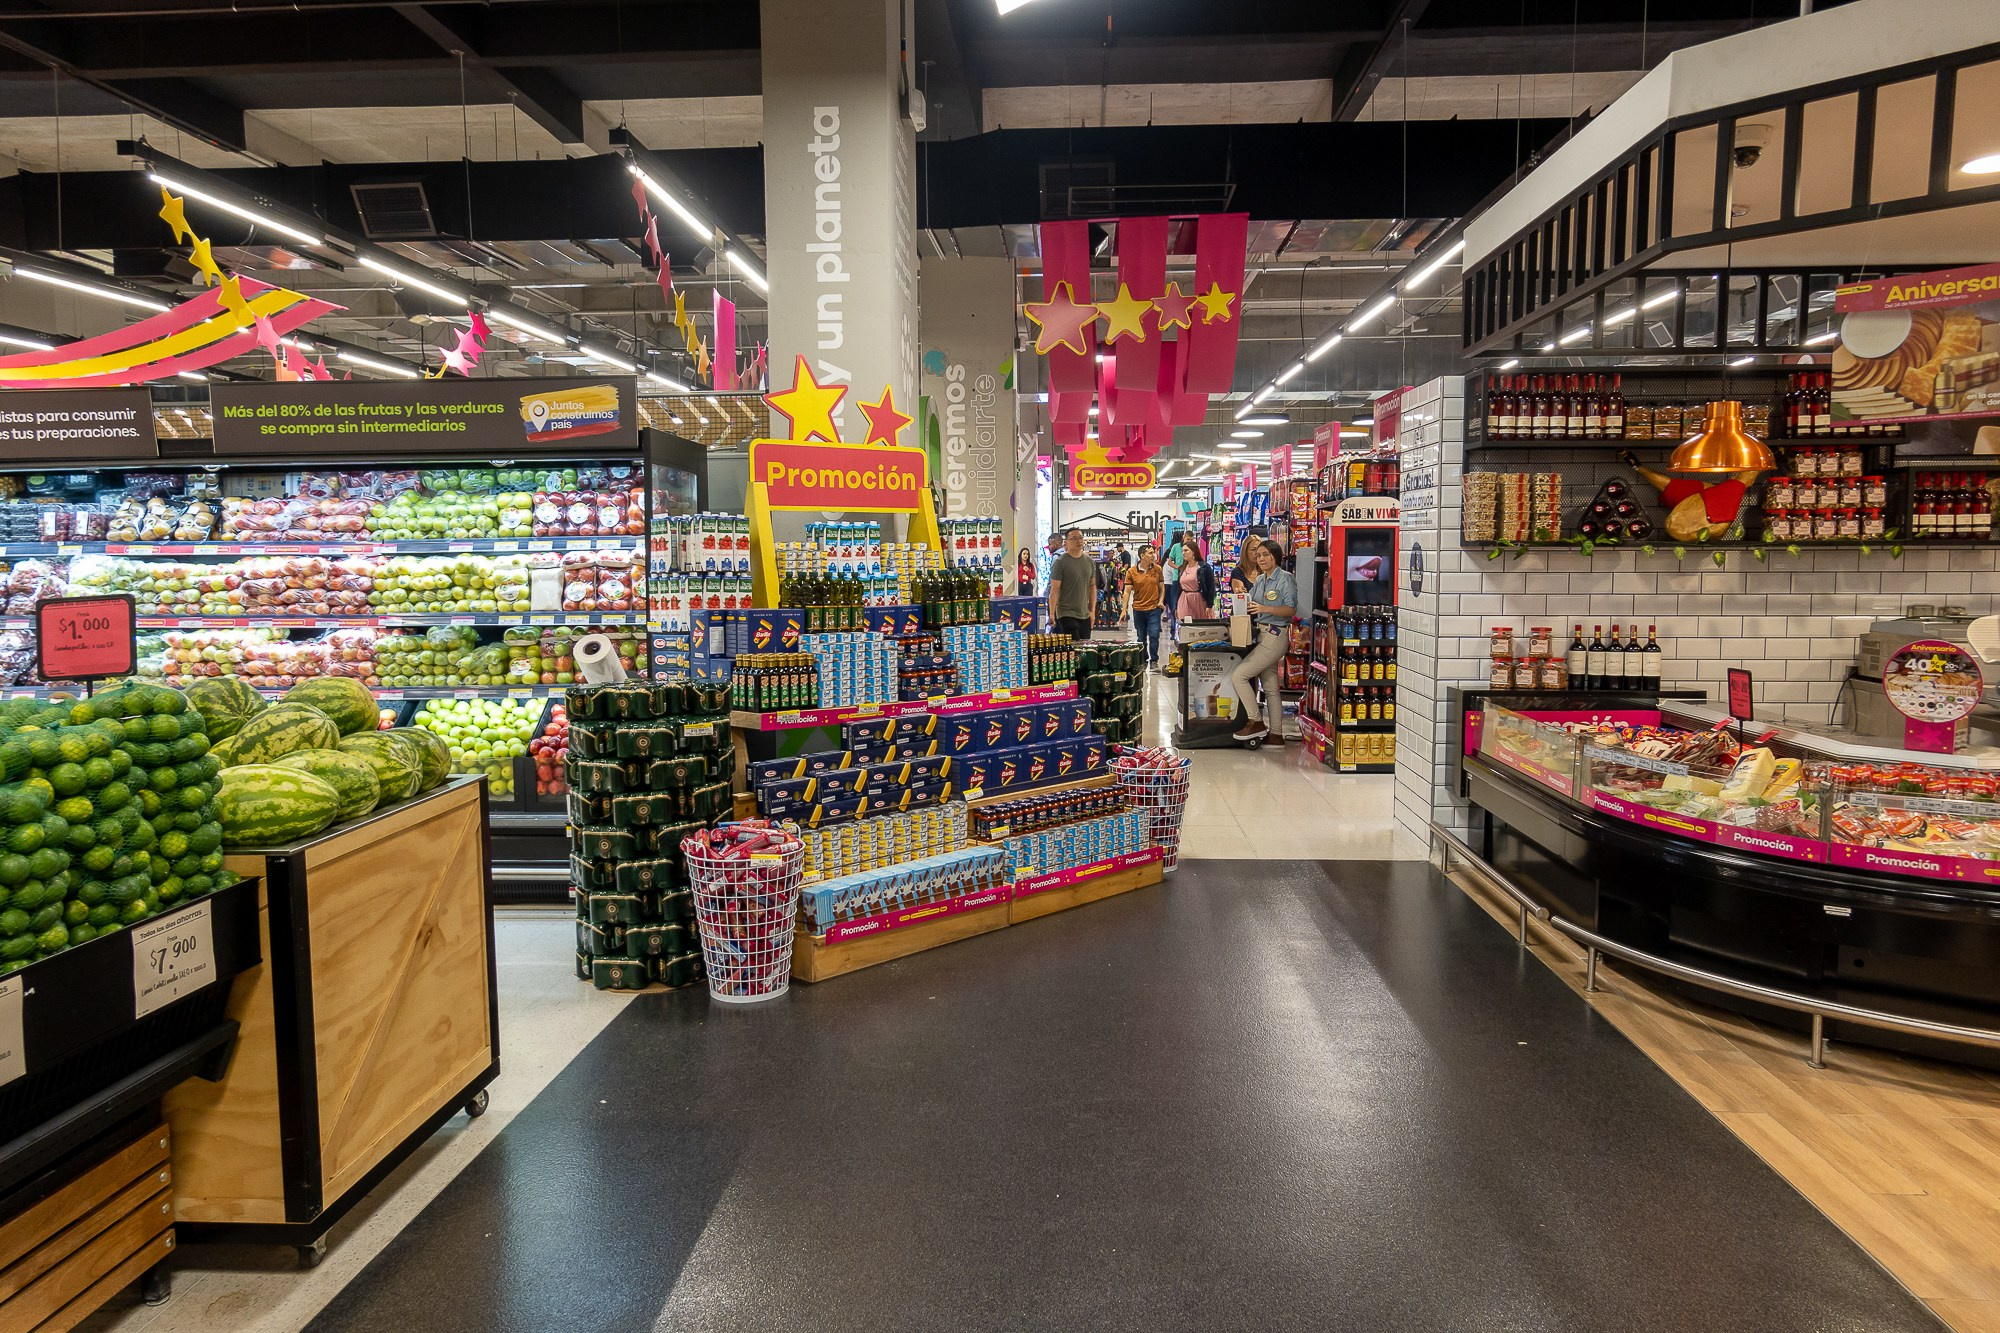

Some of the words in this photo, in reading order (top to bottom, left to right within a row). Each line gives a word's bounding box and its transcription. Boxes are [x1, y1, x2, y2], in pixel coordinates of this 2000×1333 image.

[806, 106, 850, 283] planeta
[1908, 298, 1928, 306] febrero
[816, 294, 844, 349] un
[223, 405, 254, 418] Más
[256, 405, 278, 417] del
[280, 405, 311, 417] 80%
[313, 404, 332, 416] de
[335, 404, 356, 416] las
[358, 403, 402, 416] frutas
[404, 404, 415, 417] y
[417, 403, 438, 415] las
[439, 402, 505, 414] verduras
[550, 401, 585, 410] Juntos
[37, 410, 63, 425] para
[65, 408, 137, 422] consumir
[551, 410, 614, 419] construimos
[260, 425, 276, 434] se
[278, 424, 335, 436] compra
[337, 421, 359, 433] sin
[361, 419, 466, 433] intermediarios
[551, 419, 573, 431] país
[11, 427, 34, 441] tus
[37, 425, 140, 442] preparaciones.
[945, 363, 967, 519] ueremos
[767, 461, 916, 491] Promoción
[1081, 470, 1147, 485] Promo
[59, 617, 110, 639] $1.000
[1910, 644, 1957, 652] Aniversario
[1039, 690, 1065, 698] Promoción
[942, 700, 973, 710] Promoción
[1594, 795, 1624, 813] Promoción
[1733, 832, 1794, 853] Promoción
[1125, 854, 1151, 865] Promoción
[1865, 853, 1940, 871] Promoción
[1030, 876, 1060, 890] Promoción
[964, 894, 997, 907] Promoción
[140, 929, 156, 939] Todos
[164, 922, 176, 931] días
[841, 921, 879, 936] Promoción
